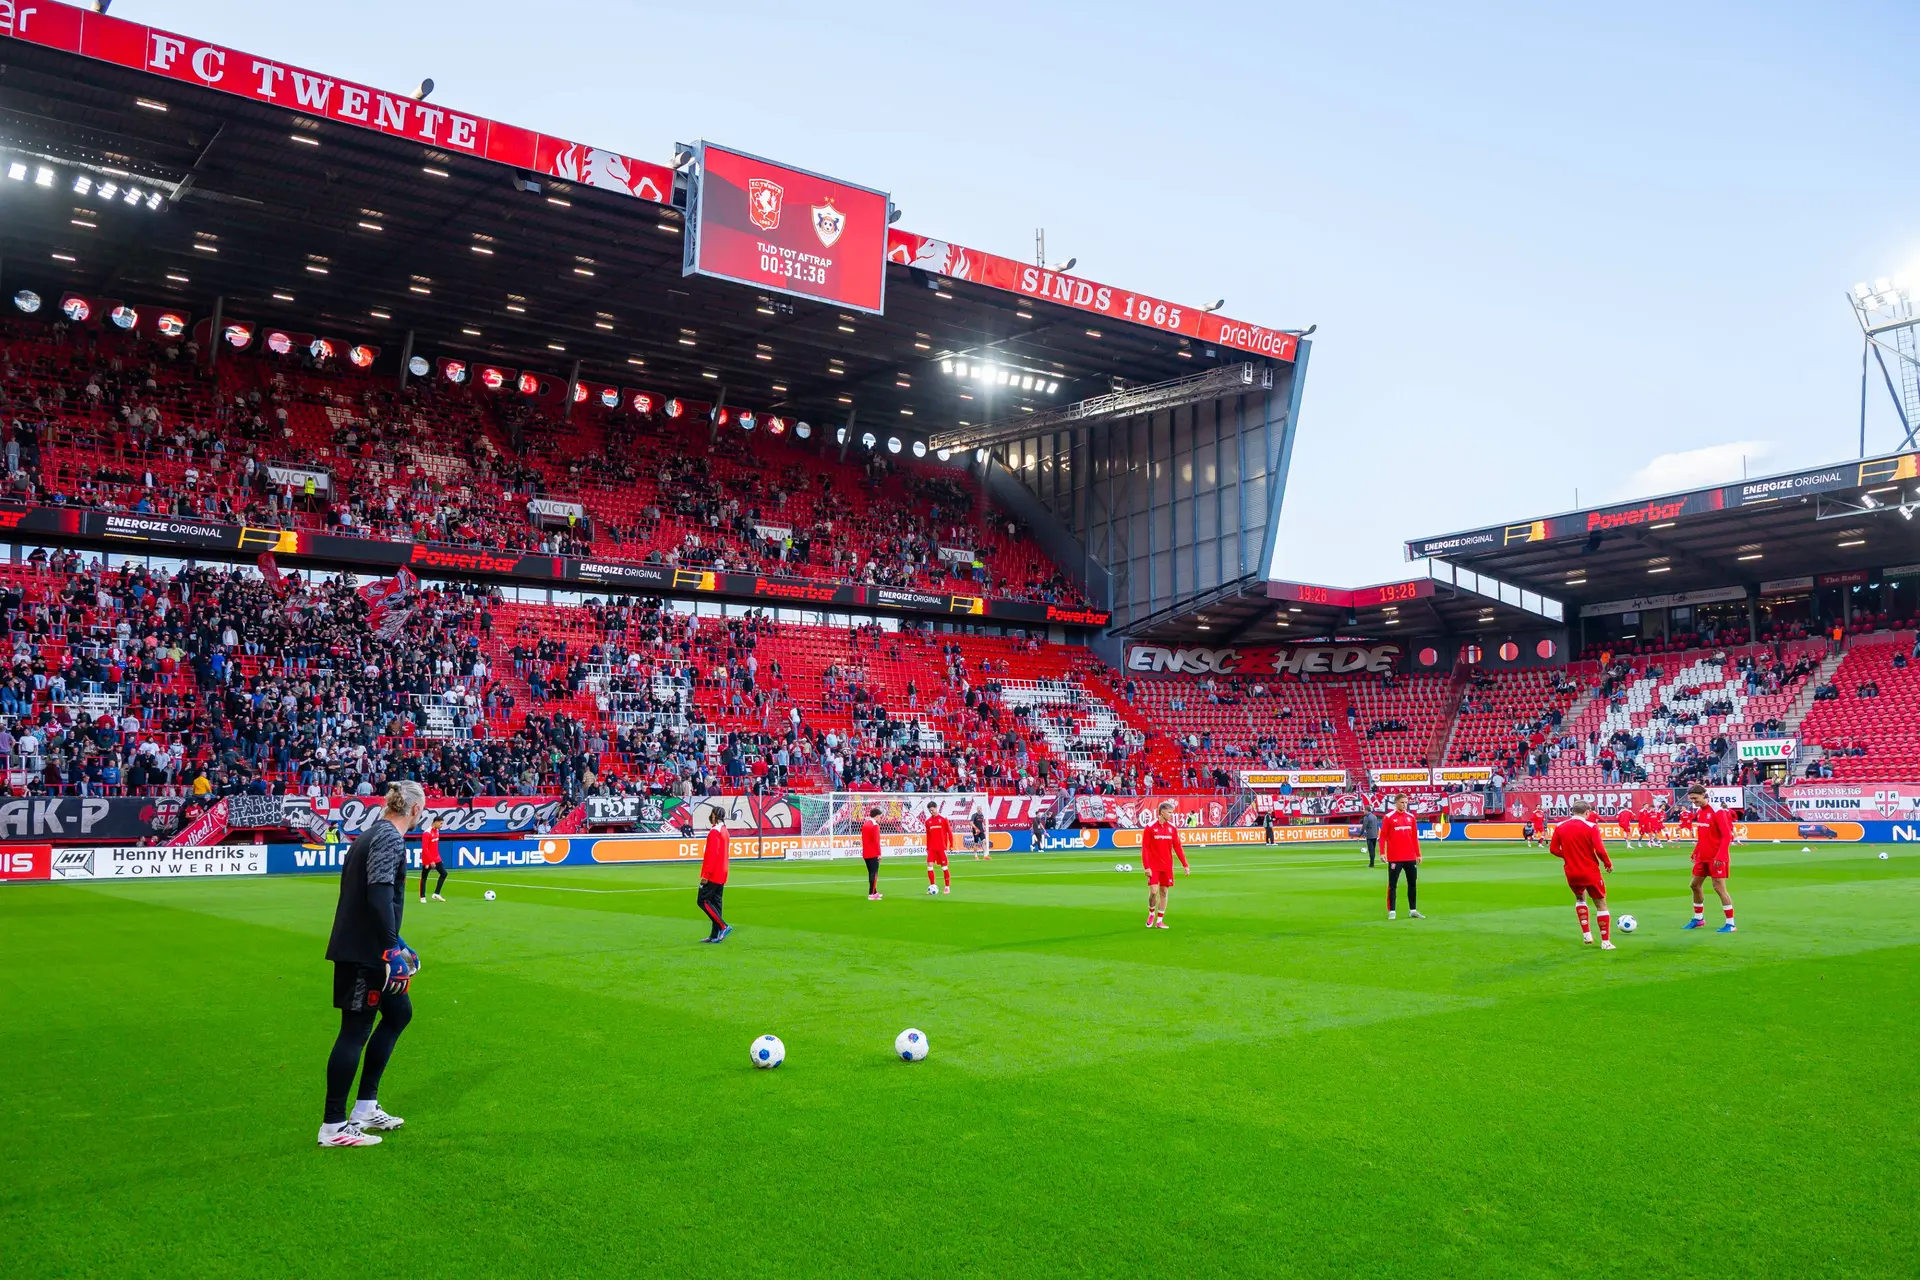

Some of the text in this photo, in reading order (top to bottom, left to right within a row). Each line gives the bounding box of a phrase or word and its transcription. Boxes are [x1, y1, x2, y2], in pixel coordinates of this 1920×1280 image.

[149, 33, 478, 149] FC TWENTE
[757, 241, 833, 268] TIJD TOT AFTRAP
[760, 254, 826, 285] 00:31:38
[1021, 267, 1182, 329] SINDS 1965
[1219, 323, 1290, 355] previder
[1743, 472, 1842, 495] ENERGIZE ORIGINAL
[538, 502, 576, 516] VICTA
[1586, 497, 1687, 532] Powerbar
[106, 515, 223, 538] ENERGIZE ORIGINAL
[1424, 534, 1494, 552] ENERGIZE ORIGINAL
[410, 544, 521, 573] Powerbar
[580, 563, 662, 580] ENERGIZE ORIGINAL
[1824, 576, 1839, 584] The
[754, 577, 840, 601] Powerbar
[1298, 585, 1328, 603] 19:28
[1379, 582, 1416, 601] 19:28
[878, 590, 913, 601] ENERGIZE
[912, 594, 942, 605] ORIGINAL
[1046, 605, 1112, 626] Powerbar
[1742, 740, 1792, 757] univé
[1248, 774, 1290, 784] EUROJACKPOT
[1299, 774, 1345, 784] EUROJACKPOT
[1380, 773, 1429, 782] EUROJACKPOT
[1793, 787, 1862, 796] HARDENBERG
[1540, 793, 1633, 809] BAGPIPE
[1815, 799, 1861, 809] UNION
[1807, 812, 1849, 820] ZWOLLE
[1188, 832, 1208, 842] KAN
[1210, 830, 1233, 842] HÉÉL
[1236, 831, 1266, 841] TWENT
[1274, 830, 1285, 840] DE
[1287, 830, 1303, 840] POT
[1305, 829, 1329, 839] WEER
[1330, 828, 1345, 838] OP!
[60, 853, 87, 863] HH
[113, 848, 167, 862] Henny
[172, 847, 245, 861] Hendriks
[679, 843, 699, 857] DE
[893, 846, 926, 856] ggmgastr
[115, 862, 259, 876] ZONWERING
